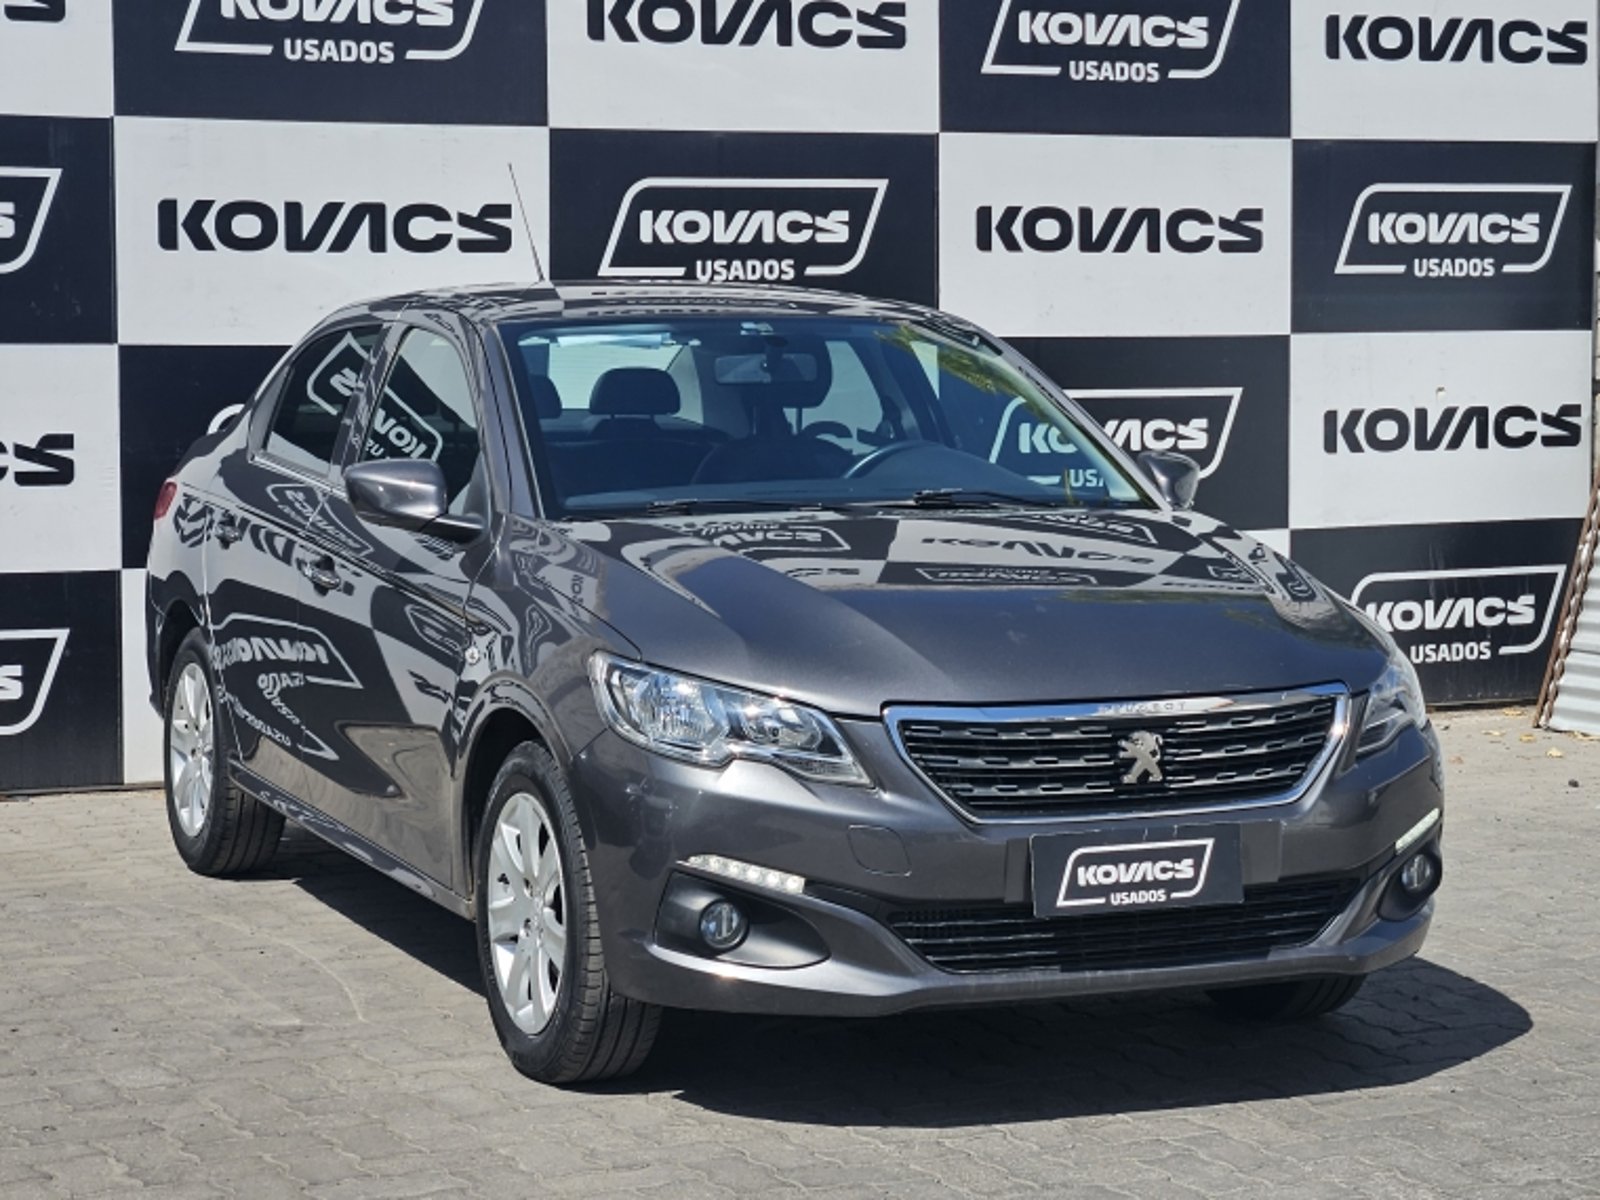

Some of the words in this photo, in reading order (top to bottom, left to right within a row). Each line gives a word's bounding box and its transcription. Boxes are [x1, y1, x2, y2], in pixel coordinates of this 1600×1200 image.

[586, 0, 907, 49] KOVACS
[1018, 11, 1209, 49] KOVACS
[1325, 14, 1588, 65] KOVACS
[284, 38, 395, 64] USADOS
[1069, 60, 1160, 83] USADOS
[157, 198, 513, 254] KOVACS
[639, 209, 850, 244] KOVACS
[975, 205, 1264, 254] KOVACS
[1368, 212, 1540, 244] KOVACS
[695, 259, 795, 282] USADOS
[1413, 257, 1495, 278] USADOS
[1323, 403, 1582, 454] KOVACS
[1365, 594, 1536, 632] KOVACS
[1410, 641, 1492, 664] USADOS
[1077, 858, 1195, 887] KOVACS
[1110, 888, 1167, 906] USADOS
